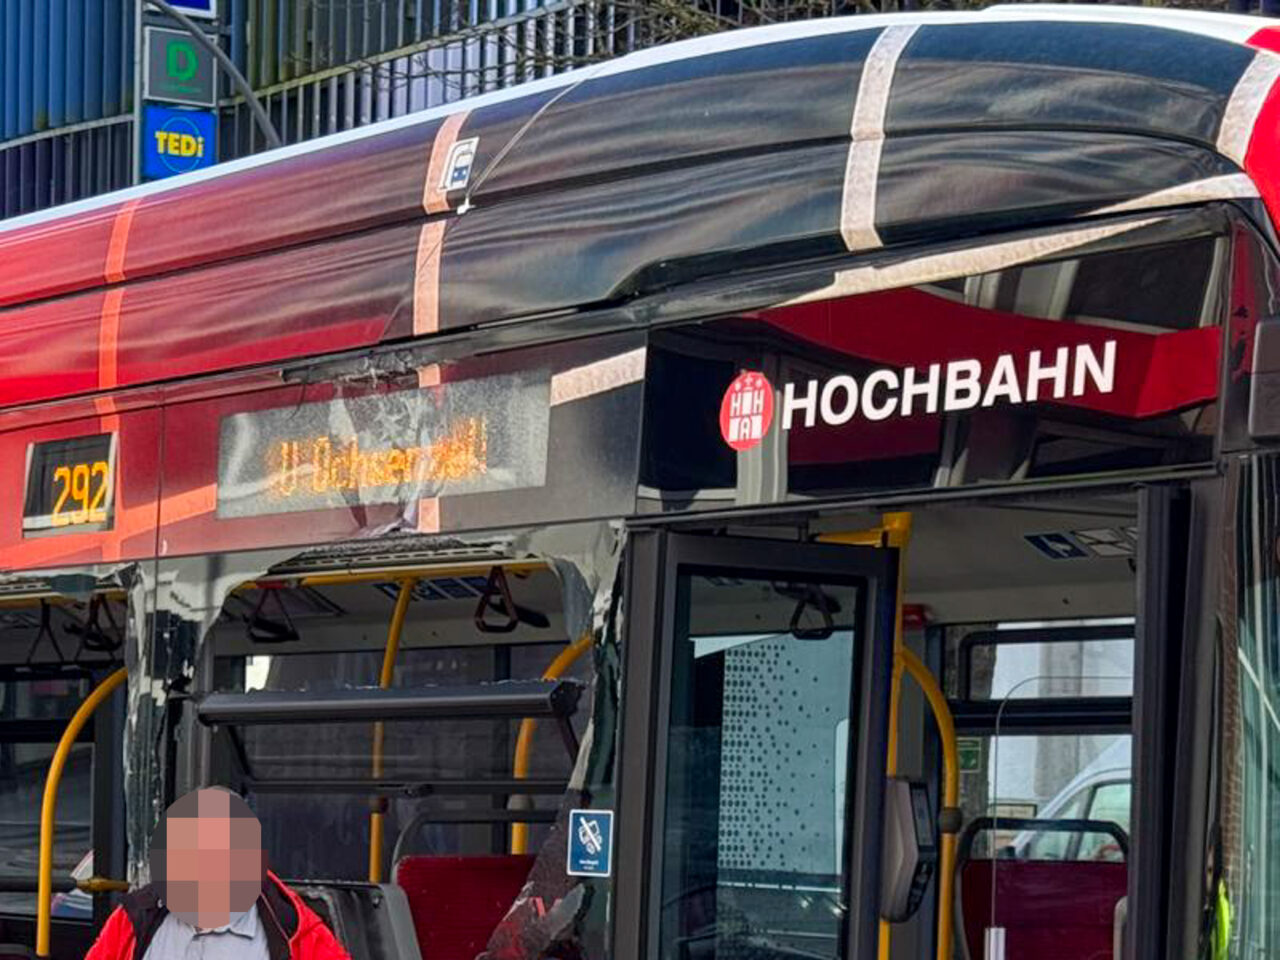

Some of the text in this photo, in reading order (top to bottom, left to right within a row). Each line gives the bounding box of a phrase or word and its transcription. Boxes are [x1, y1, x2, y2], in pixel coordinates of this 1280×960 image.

[166, 40, 198, 80] D
[155, 131, 205, 158] TEDi
[782, 340, 1117, 430] HOCHBAHN
[51, 461, 108, 527] 292
